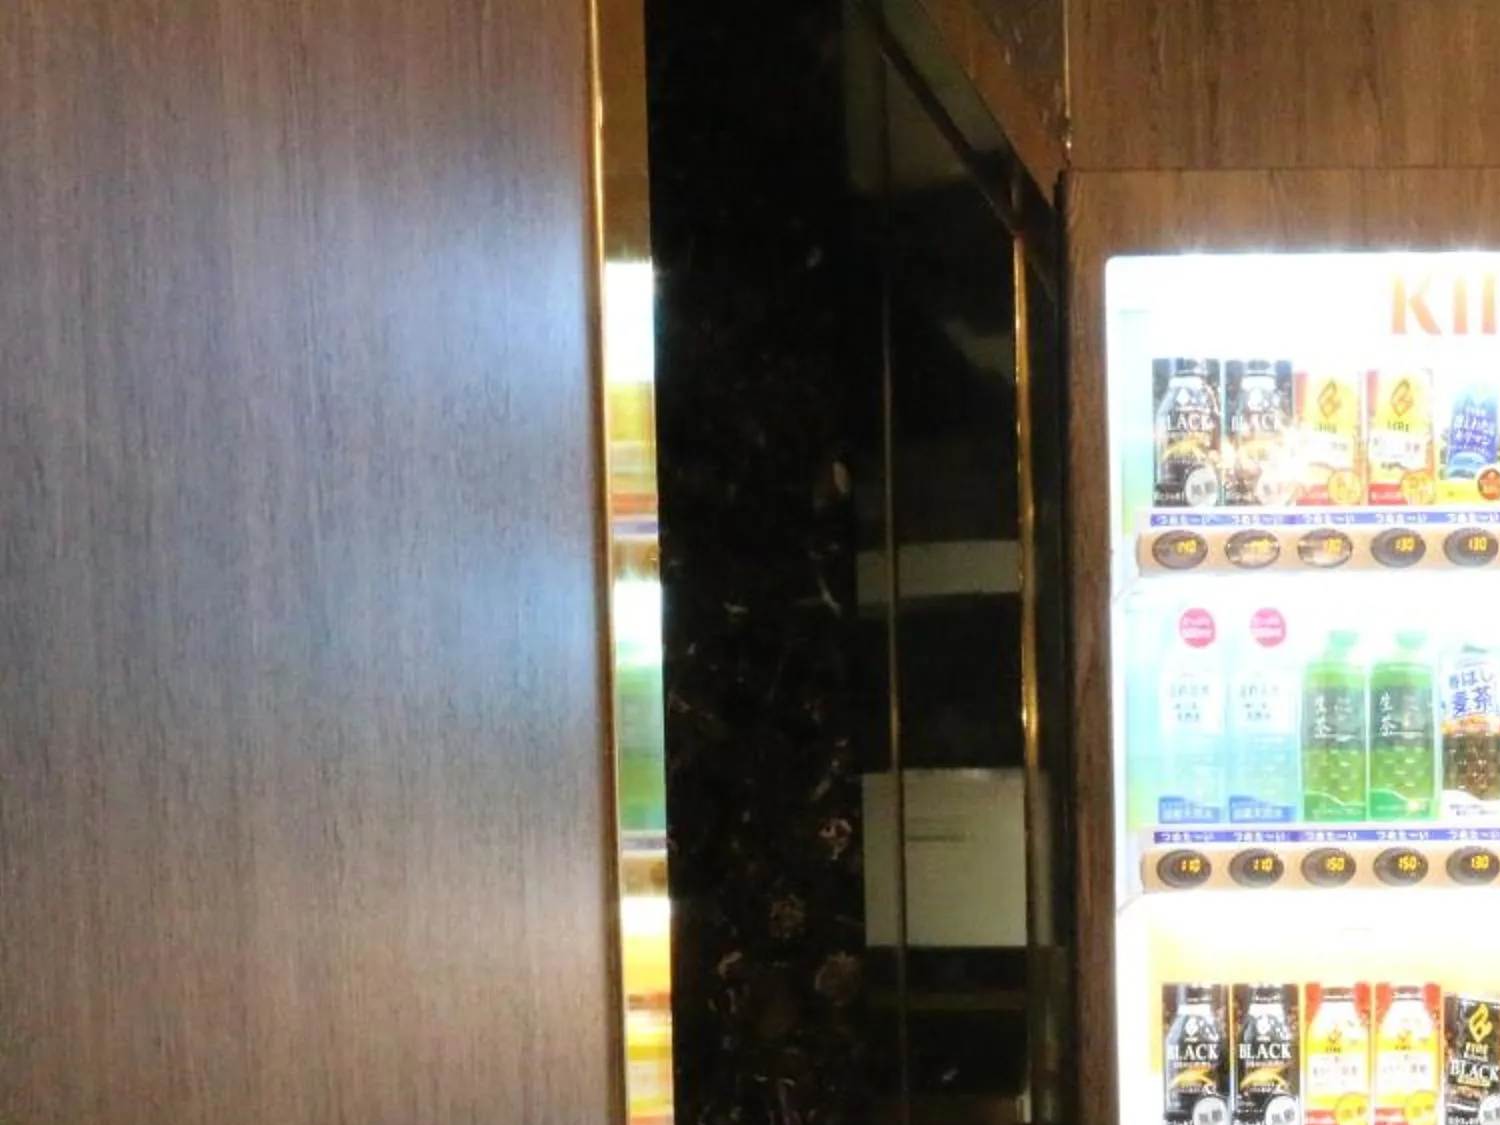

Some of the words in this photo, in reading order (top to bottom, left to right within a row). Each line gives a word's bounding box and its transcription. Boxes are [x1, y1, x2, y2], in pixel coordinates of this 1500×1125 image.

[1380, 691, 1398, 737] 生茶
[1180, 859, 1201, 872] 110
[1253, 858, 1274, 872] 110
[1239, 1043, 1292, 1060] BLACK
[1450, 1058, 1499, 1081] BLACK
